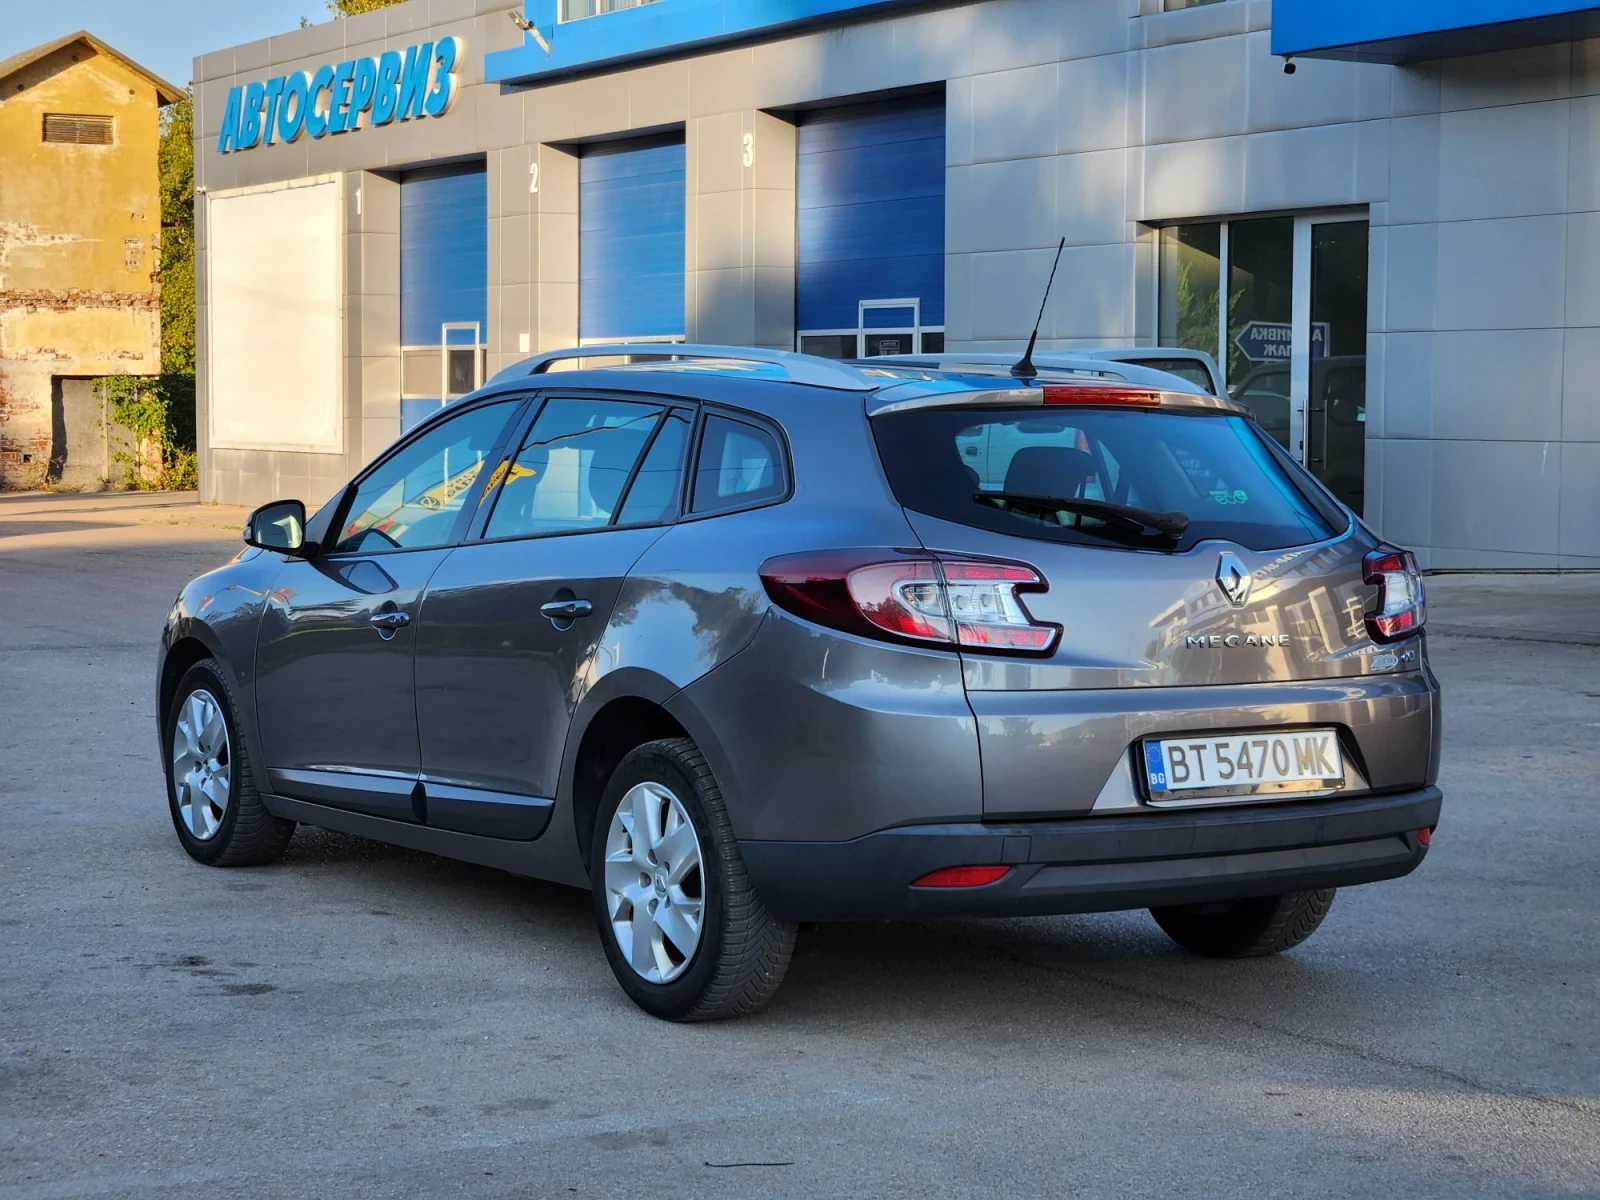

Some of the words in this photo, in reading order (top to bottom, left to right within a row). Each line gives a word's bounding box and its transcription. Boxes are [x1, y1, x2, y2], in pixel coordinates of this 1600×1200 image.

[217, 36, 459, 153] АВТОСЕРВИЗ
[742, 132, 754, 168] 3
[529, 162, 539, 194] 2
[354, 187, 362, 216] 1
[1186, 634, 1290, 649] MEGANE
[1168, 744, 1208, 783] BT
[1215, 739, 1291, 780] 5470
[1293, 736, 1335, 776] MK
[1150, 772, 1166, 785] BG
